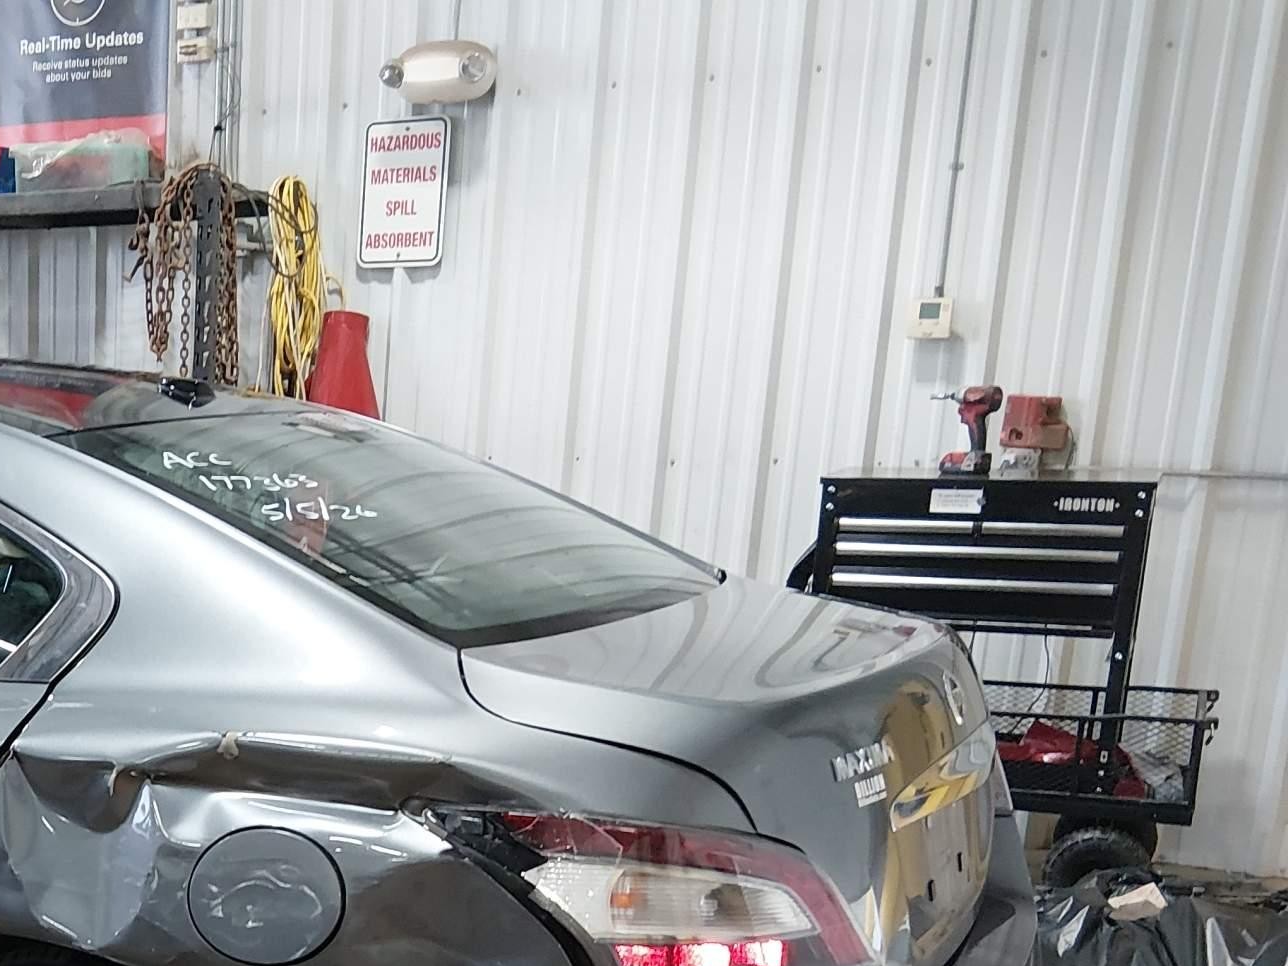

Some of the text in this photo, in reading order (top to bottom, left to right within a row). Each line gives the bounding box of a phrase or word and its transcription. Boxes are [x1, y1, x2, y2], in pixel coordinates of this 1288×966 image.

[20, 31, 144, 56] Real-Time Updates
[33, 55, 128, 72] Receive status updates
[46, 67, 112, 83] about your bids
[370, 132, 442, 153] HAZARDOUS
[370, 165, 437, 185] MATERIALS
[385, 200, 417, 217] SPILL
[365, 231, 435, 250] ABSORBENT
[162, 451, 232, 470] ACC
[260, 496, 379, 522] 5/5/26
[1058, 497, 1115, 512] IRONTON
